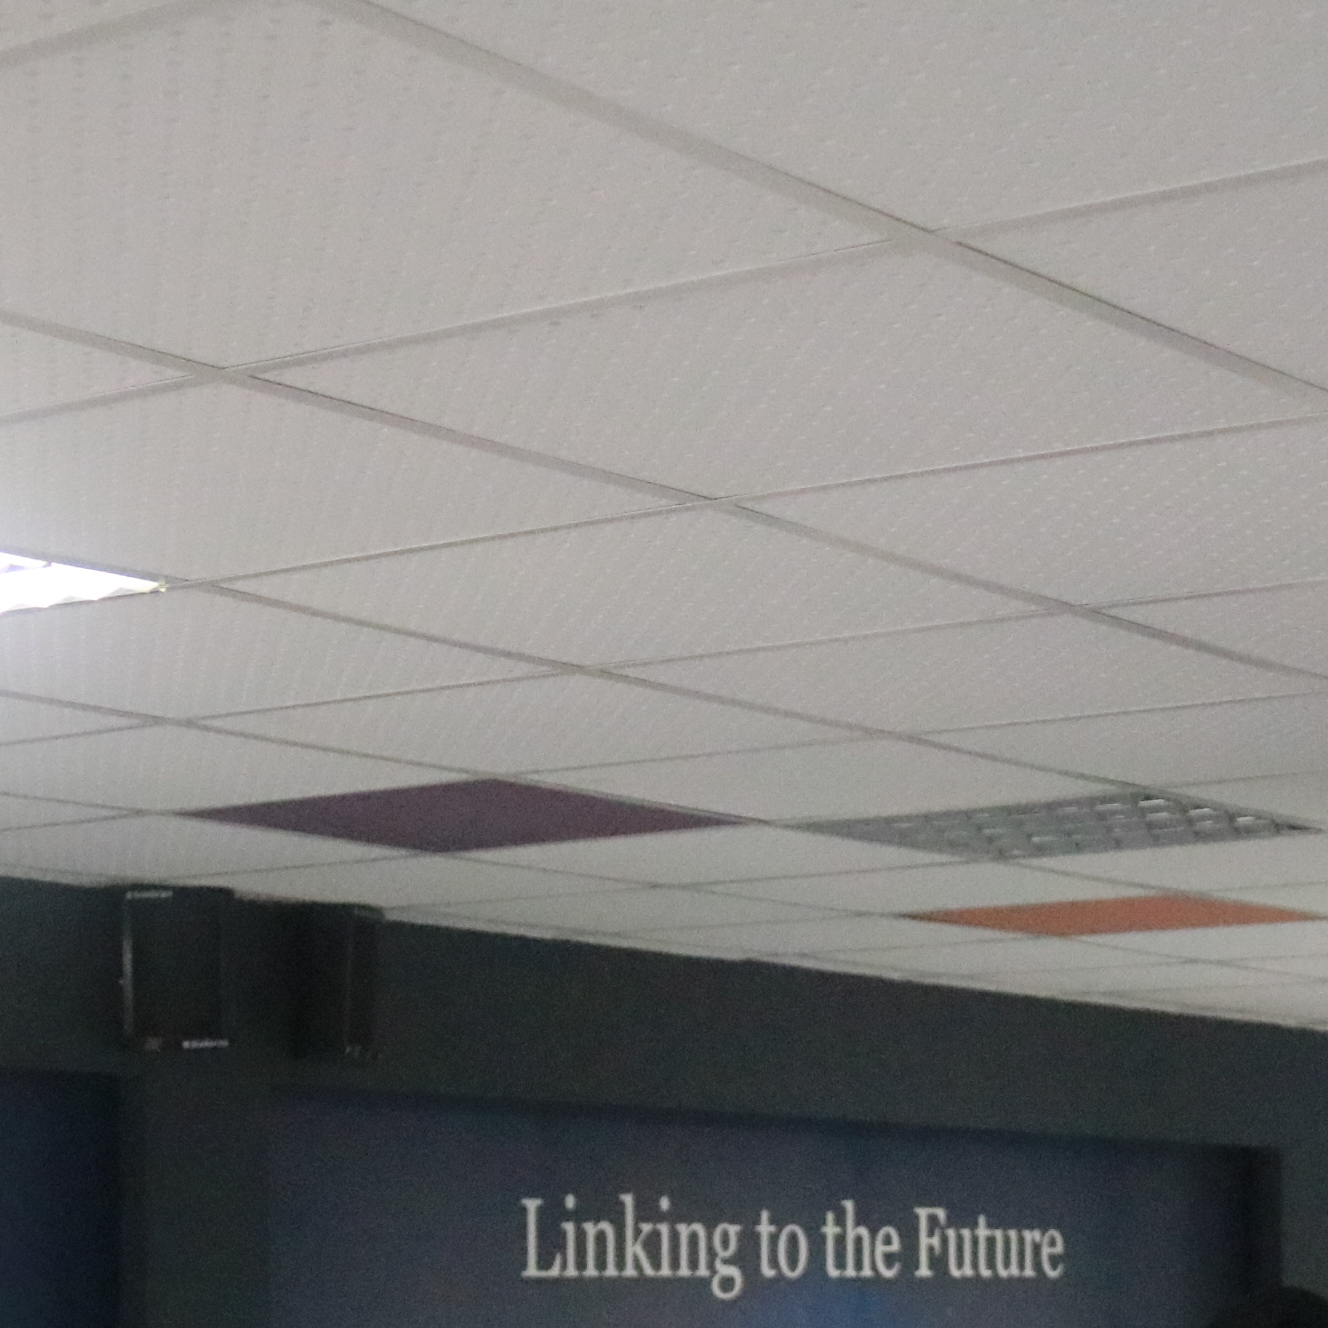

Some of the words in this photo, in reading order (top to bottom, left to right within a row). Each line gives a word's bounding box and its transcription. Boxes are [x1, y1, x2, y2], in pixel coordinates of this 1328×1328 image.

[520, 1193, 743, 1300] Linking
[755, 1208, 809, 1279] to
[821, 1199, 901, 1279] the
[913, 1206, 1065, 1279] Future
